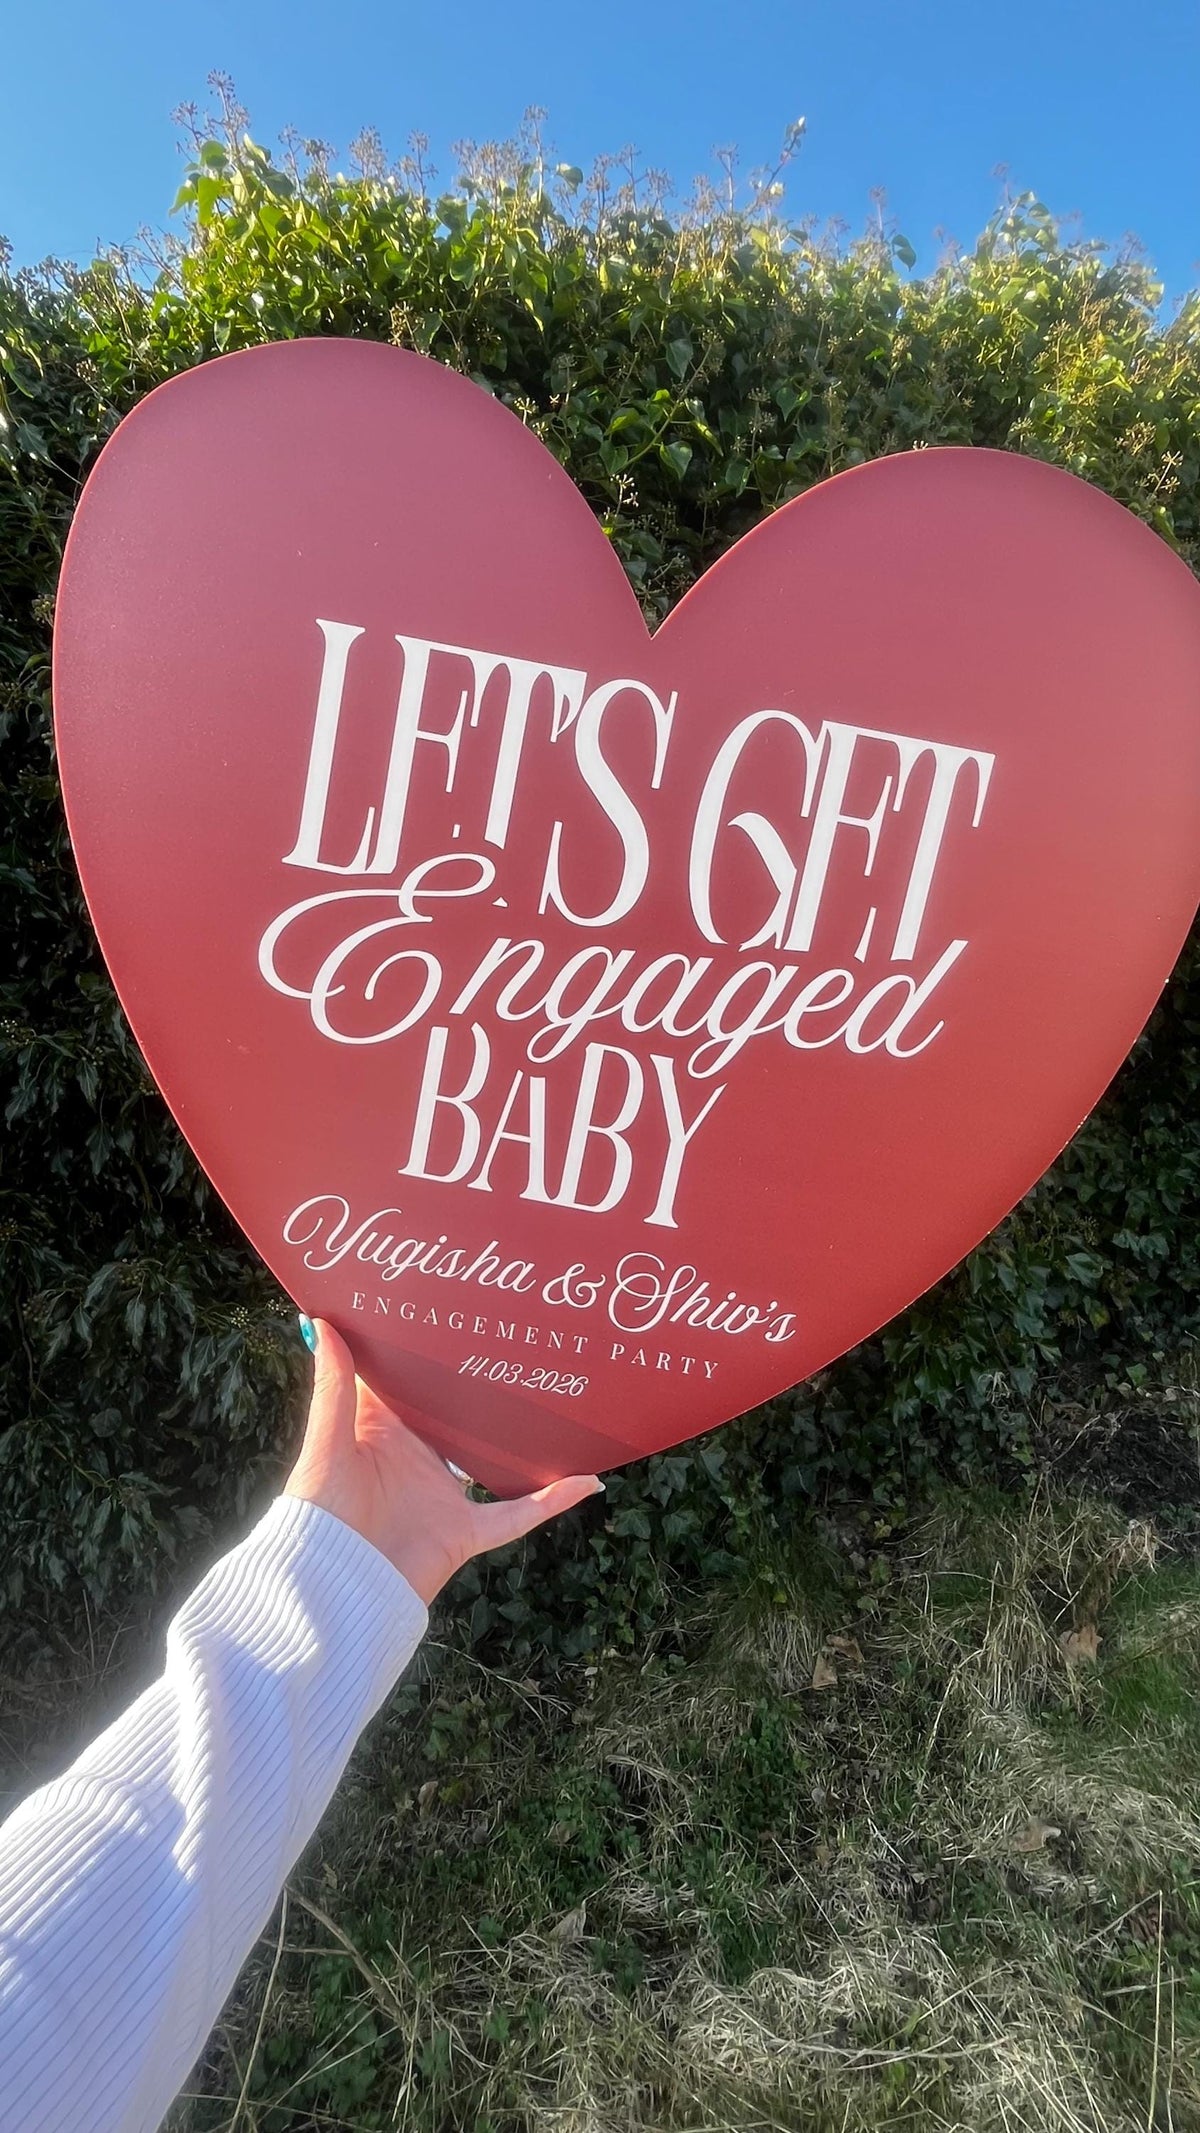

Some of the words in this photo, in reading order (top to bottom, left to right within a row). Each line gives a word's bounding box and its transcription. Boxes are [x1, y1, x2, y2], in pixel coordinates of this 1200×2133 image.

[282, 618, 678, 927] LET'S
[688, 708, 997, 963] GET
[257, 853, 969, 1079] Engaged
[398, 1022, 728, 1229] BABY
[282, 1194, 538, 1293] Yugisha
[542, 1263, 606, 1309] &
[608, 1252, 798, 1344] Shiv's
[352, 1291, 590, 1355] ENGAGEMENT
[611, 1343, 720, 1380] PARTY
[457, 1354, 590, 1397] 14.03.2026
